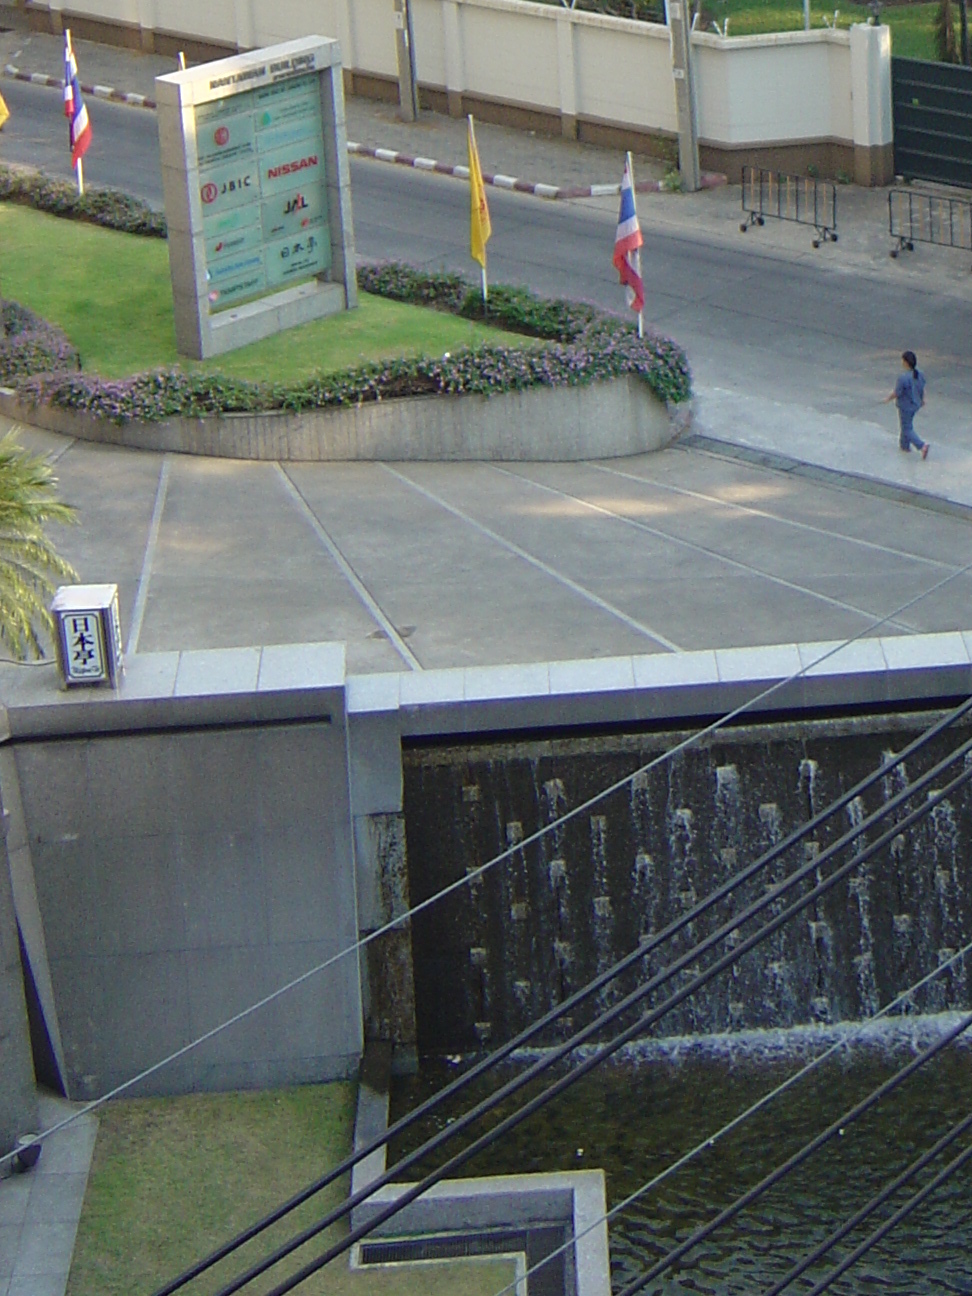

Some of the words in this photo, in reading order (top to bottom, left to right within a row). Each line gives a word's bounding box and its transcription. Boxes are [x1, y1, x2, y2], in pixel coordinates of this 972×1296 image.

[268, 156, 318, 179] NISSAN
[221, 176, 251, 194] JBIC
[284, 193, 308, 214] JAL
[72, 617, 95, 666] 日本亭
